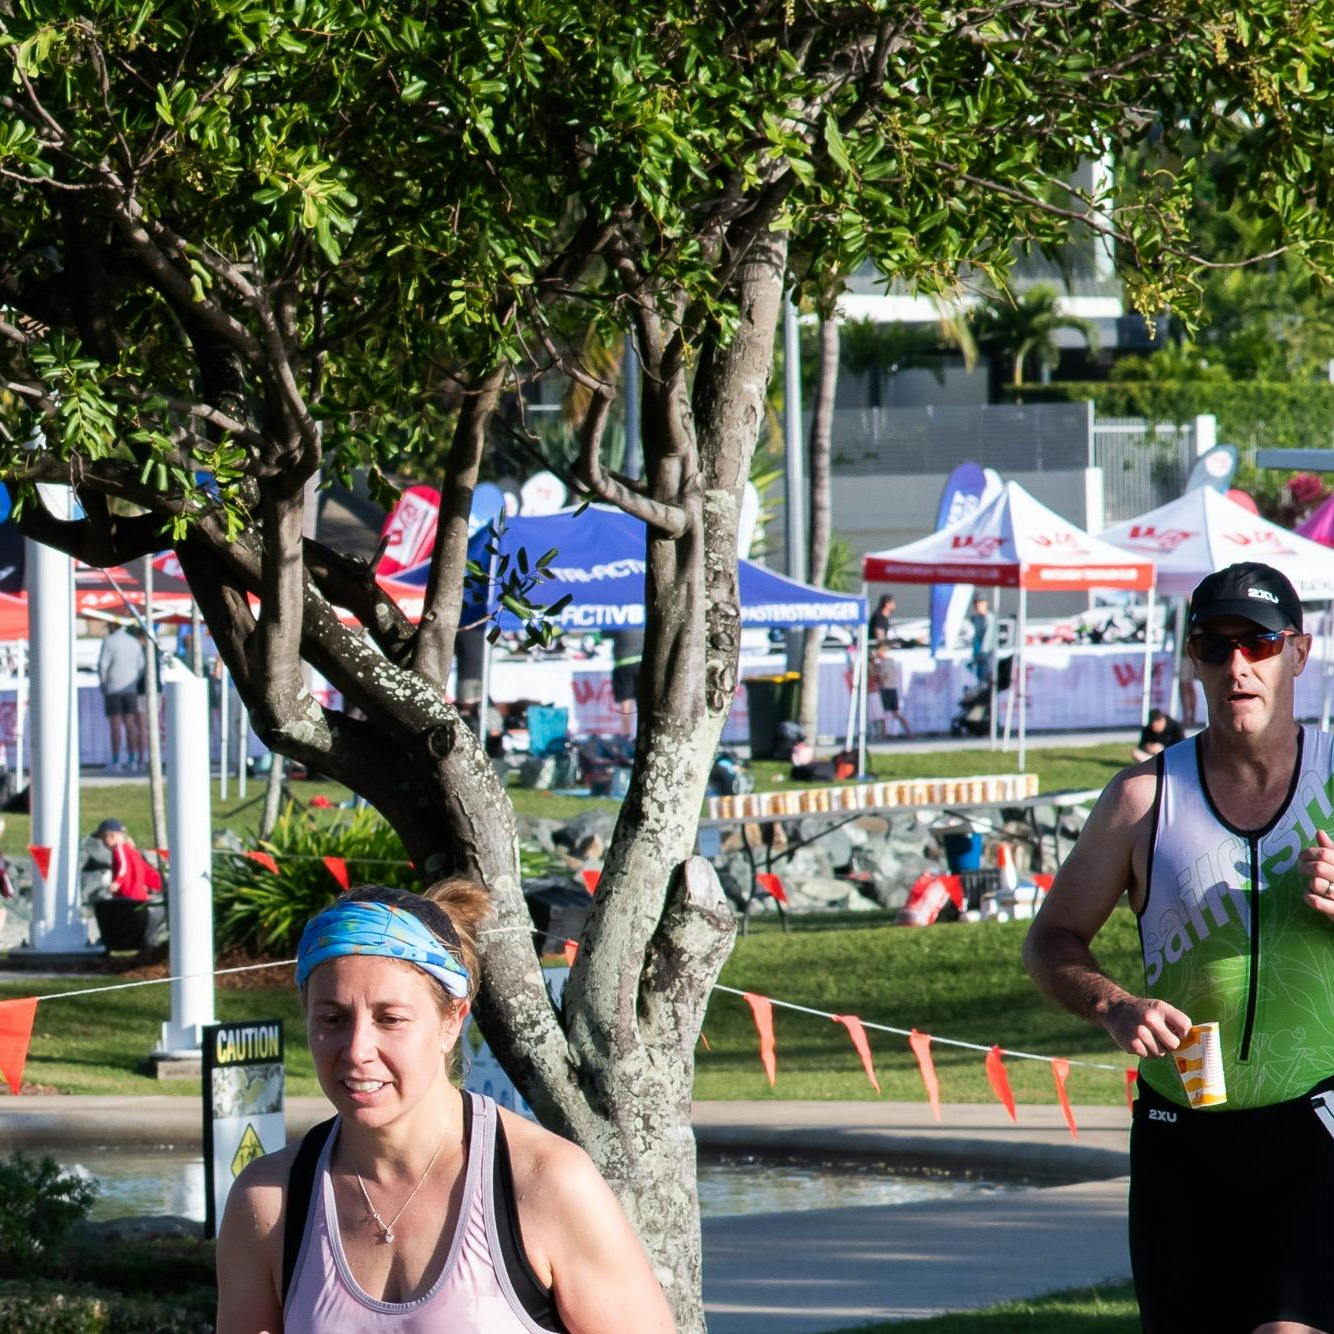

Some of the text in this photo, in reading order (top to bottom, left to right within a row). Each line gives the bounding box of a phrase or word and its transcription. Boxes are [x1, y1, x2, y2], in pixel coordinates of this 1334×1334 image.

[1247, 587, 1279, 604] 2XU
[217, 1026, 279, 1063] CAUTION
[1148, 1108, 1178, 1123] 2XU
